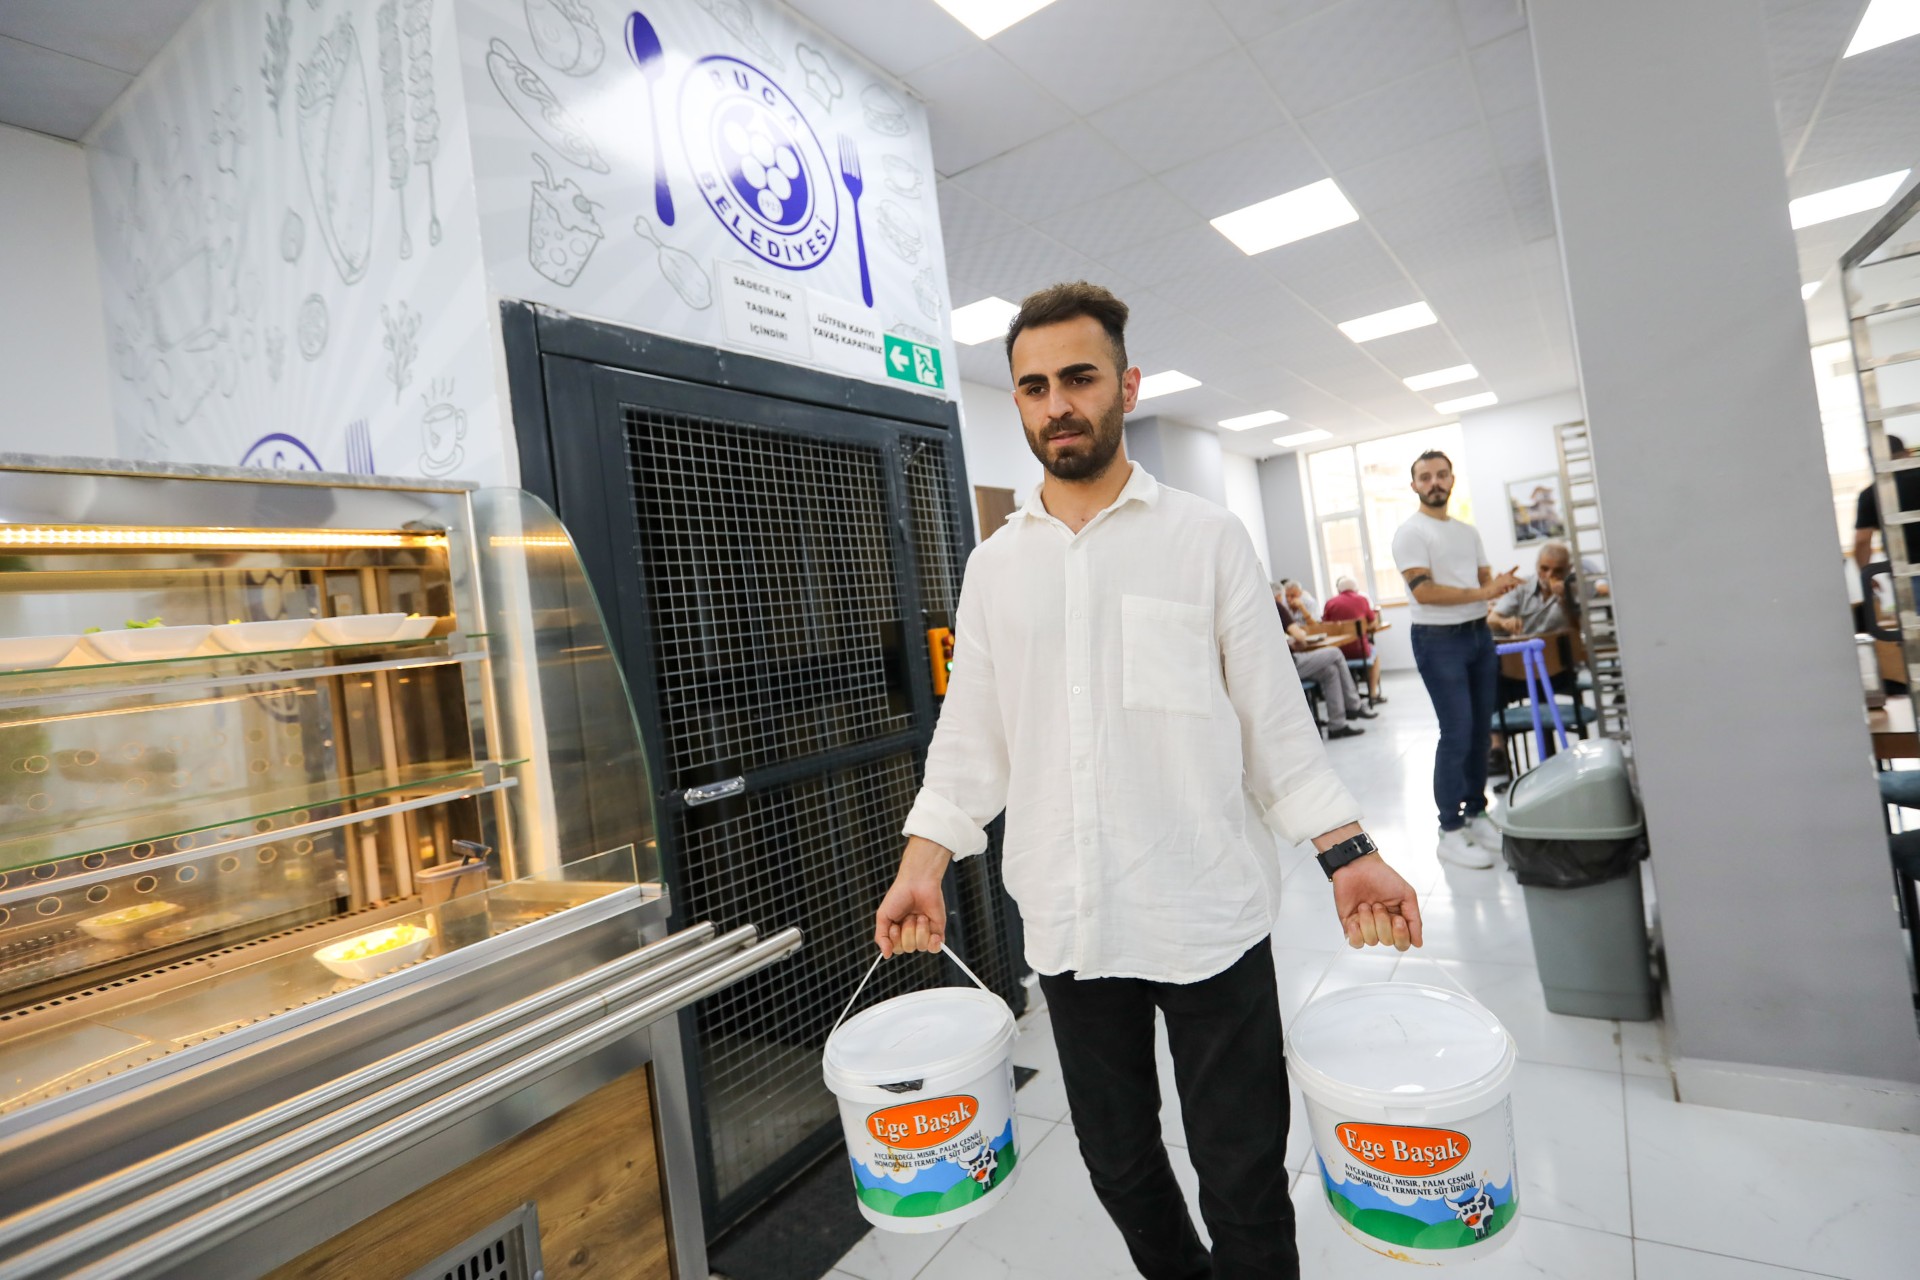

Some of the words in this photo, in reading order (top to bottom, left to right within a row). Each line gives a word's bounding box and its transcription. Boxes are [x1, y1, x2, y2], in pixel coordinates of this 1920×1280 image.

[700, 171, 832, 263] BELEDİYESİ
[733, 276, 771, 294] SADECE
[774, 289, 792, 301] YÜK
[745, 301, 787, 320] TAŞIMAK
[817, 312, 847, 329] LÜTFEN
[848, 325, 875, 339] KAPIYI
[812, 327, 840, 342] YAVAŞ
[841, 337, 883, 354] KAPATINIZ
[873, 1117, 910, 1143] Ege
[913, 1102, 973, 1134] Başak
[914, 1154, 947, 1168] FERMENTE
[949, 1149, 961, 1159] SÜT
[962, 1137, 984, 1154] ÜRÜNÜ
[940, 1142, 958, 1154] PALM
[1343, 1127, 1386, 1161] Ege
[1391, 1138, 1463, 1167] Başak
[1345, 1170, 1390, 1192] HOMOJENİZE
[1392, 1186, 1432, 1196] FERMENTE
[1434, 1186, 1448, 1196] SÜT
[1450, 1179, 1476, 1194] ÜRÜNÜ
[1423, 1179, 1445, 1188] PALM
[1447, 1171, 1475, 1187] ÇEŞNİLİ
